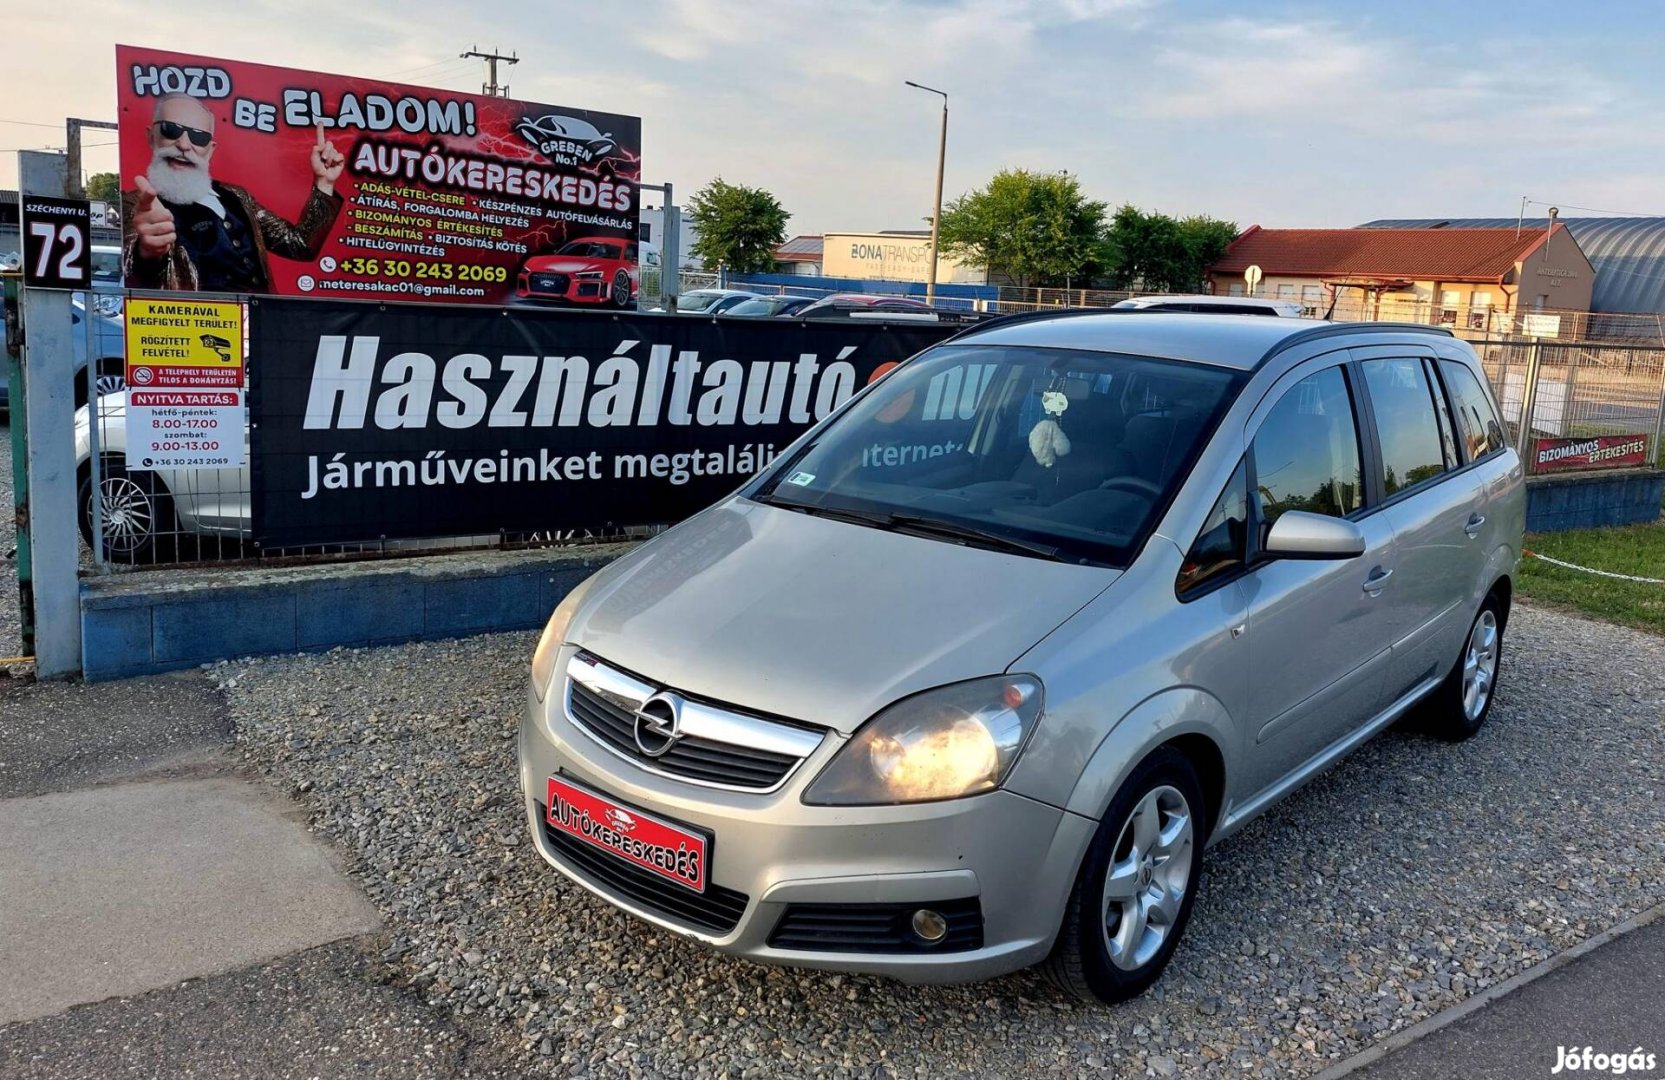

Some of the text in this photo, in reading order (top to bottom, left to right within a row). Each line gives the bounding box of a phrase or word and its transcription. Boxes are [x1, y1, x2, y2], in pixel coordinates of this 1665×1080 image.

[133, 65, 477, 136] HOZD BE ELADOM!
[541, 140, 593, 162] GREBEN
[555, 153, 578, 166] No.1
[354, 143, 631, 211] AUTÓKERESKEDÉS
[26, 204, 76, 216] SZÉCHENYI
[356, 195, 529, 228] ÁTÍRÁS, FORGALOMBA HELYEZÉS
[479, 199, 633, 230] KÉSZPÉNZES AUTÓFELVÁSÁRLÁS
[355, 209, 503, 237] BIZOMÁNYOS ÉRTÉKESÍTÉS
[355, 223, 528, 254] BESZÁMÍTÁS BIZTOSÍTÁS KÖTÉS
[30, 222, 83, 279] 72
[346, 237, 445, 257] HITELÜGYINTÉZÉS
[341, 257, 507, 282] +36 30 243 2069
[148, 305, 220, 316] KAMERÁVAL
[131, 317, 237, 329] MEGFIGYELT TERÜLET!
[141, 335, 191, 346] RÖGZÍTETT
[142, 347, 190, 357] FELVÉTEL!
[164, 368, 199, 376] TELEPHELY
[201, 368, 237, 376] TERÜLETÉN
[137, 392, 233, 404] NYITVA TARTÁS:
[151, 408, 218, 418] hétfő-péntek:
[152, 419, 218, 429] 8.00-17.00
[164, 431, 208, 439] szombat:
[151, 441, 219, 451] 9.00-13.00
[1539, 439, 1645, 463] BIZOMÁNYOS ÉRTÉKESÍTÉS
[155, 458, 171, 466] +36
[174, 458, 185, 466] 30
[206, 457, 228, 465] 2069
[301, 448, 602, 499] Járműveinket
[613, 444, 775, 484] megtalálj
[550, 792, 700, 883] AUTÓKERESKEDÉS
